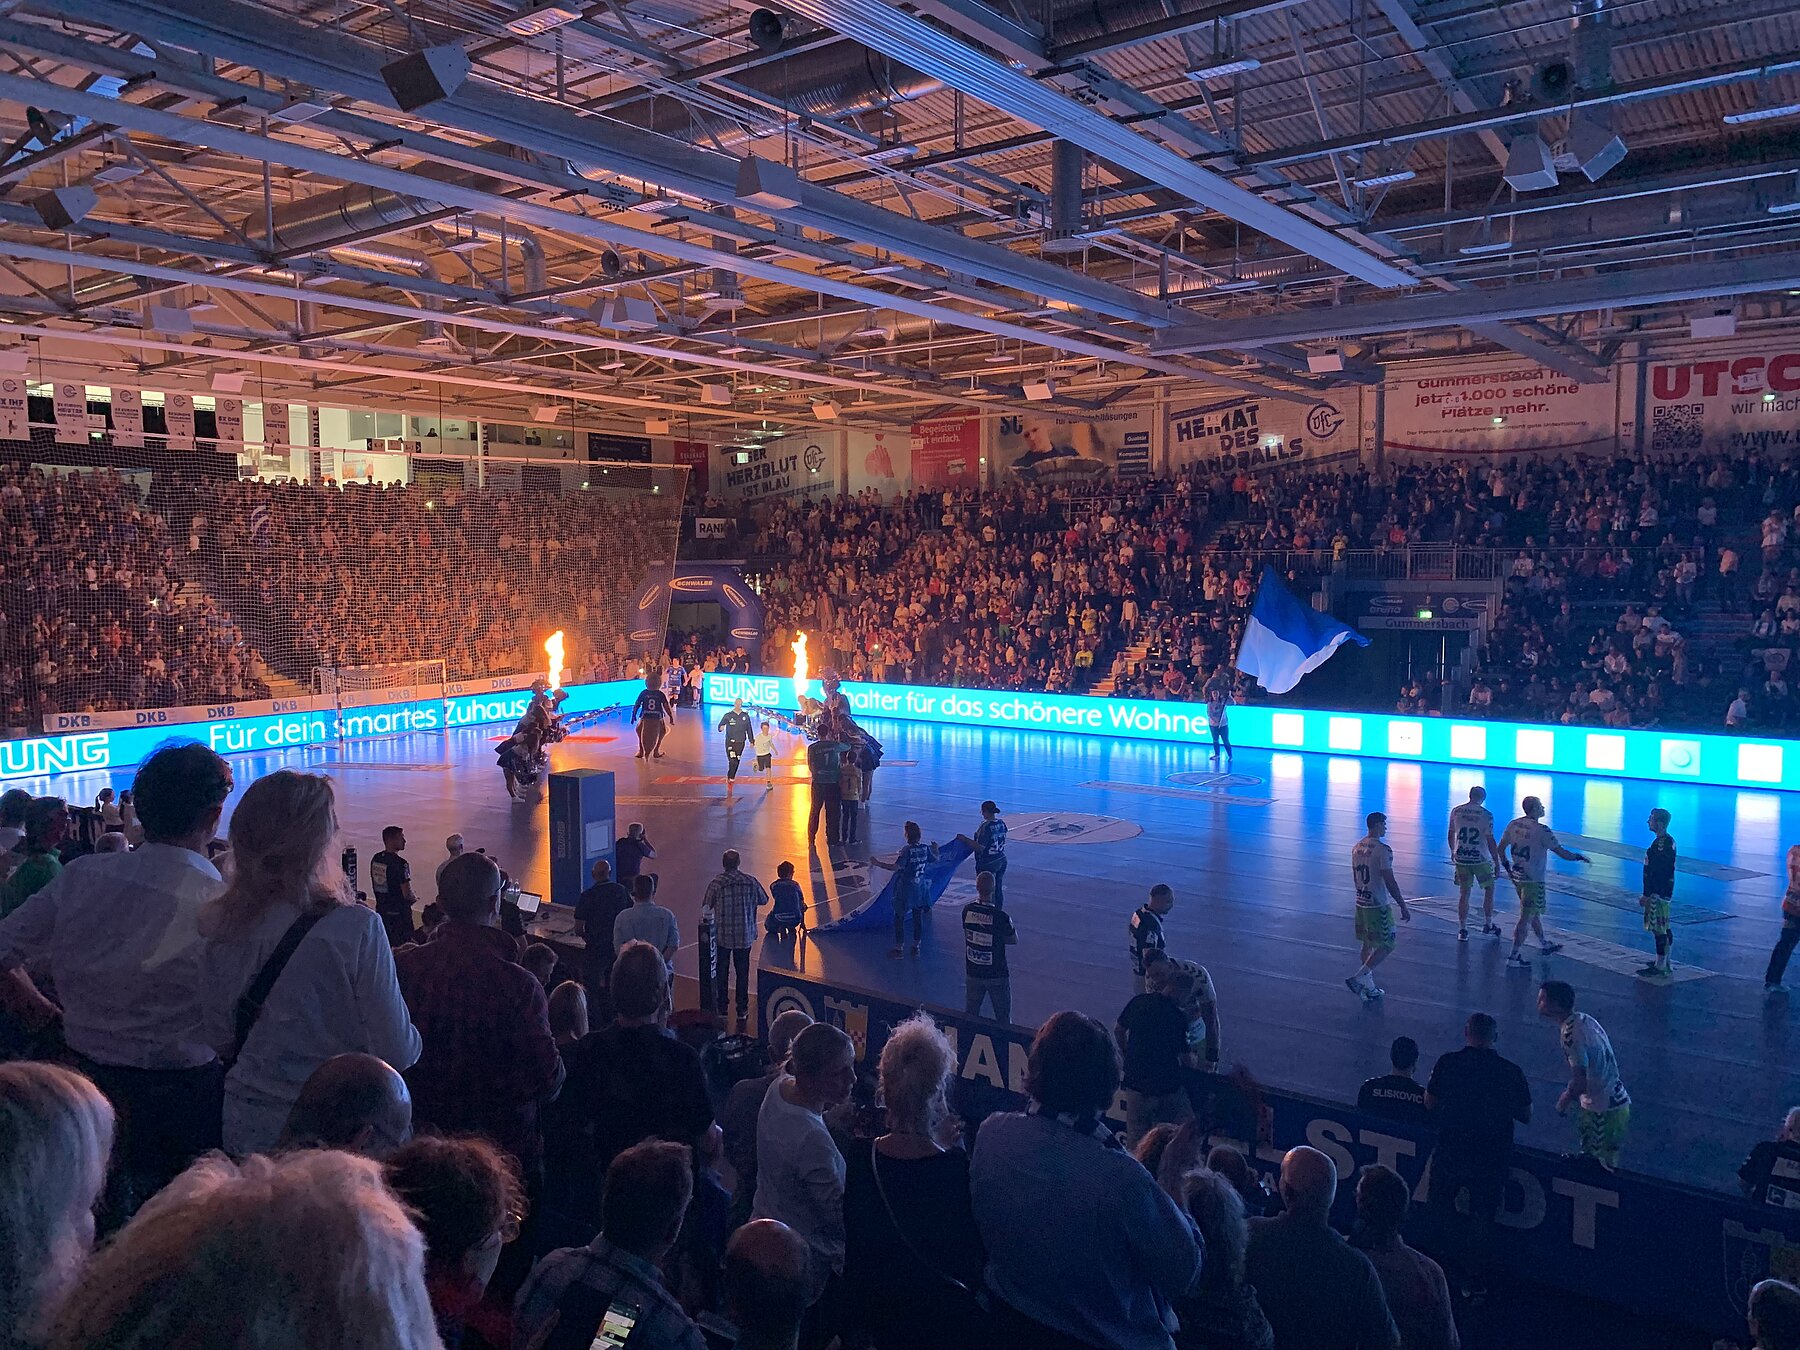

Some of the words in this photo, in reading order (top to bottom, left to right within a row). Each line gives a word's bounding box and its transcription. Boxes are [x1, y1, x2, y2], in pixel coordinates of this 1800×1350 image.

[1459, 388, 1507, 401] 1.000
[1513, 383, 1579, 398] schöne
[1499, 402, 1549, 415] mehr.
[1732, 401, 1755, 415] wir
[1220, 427, 1259, 451] DES
[1181, 438, 1304, 475] HANDBALLS
[727, 455, 797, 487] HERZBLUT
[762, 475, 790, 494] BLAU
[1385, 618, 1469, 630] Gummersbach
[710, 676, 779, 705] JUNG
[208, 706, 235, 718] DKB
[272, 701, 298, 712] DKB
[647, 698, 656, 710] 8
[58, 715, 90, 728] DKB
[136, 711, 167, 724] DKB
[907, 693, 937, 715] für
[942, 695, 983, 718] das
[989, 698, 1102, 728] schönere
[1109, 705, 1208, 735] Wohne
[209, 723, 257, 752] Für
[264, 718, 325, 745] dein
[334, 706, 437, 737] smartes
[446, 698, 533, 725] Zuhaus
